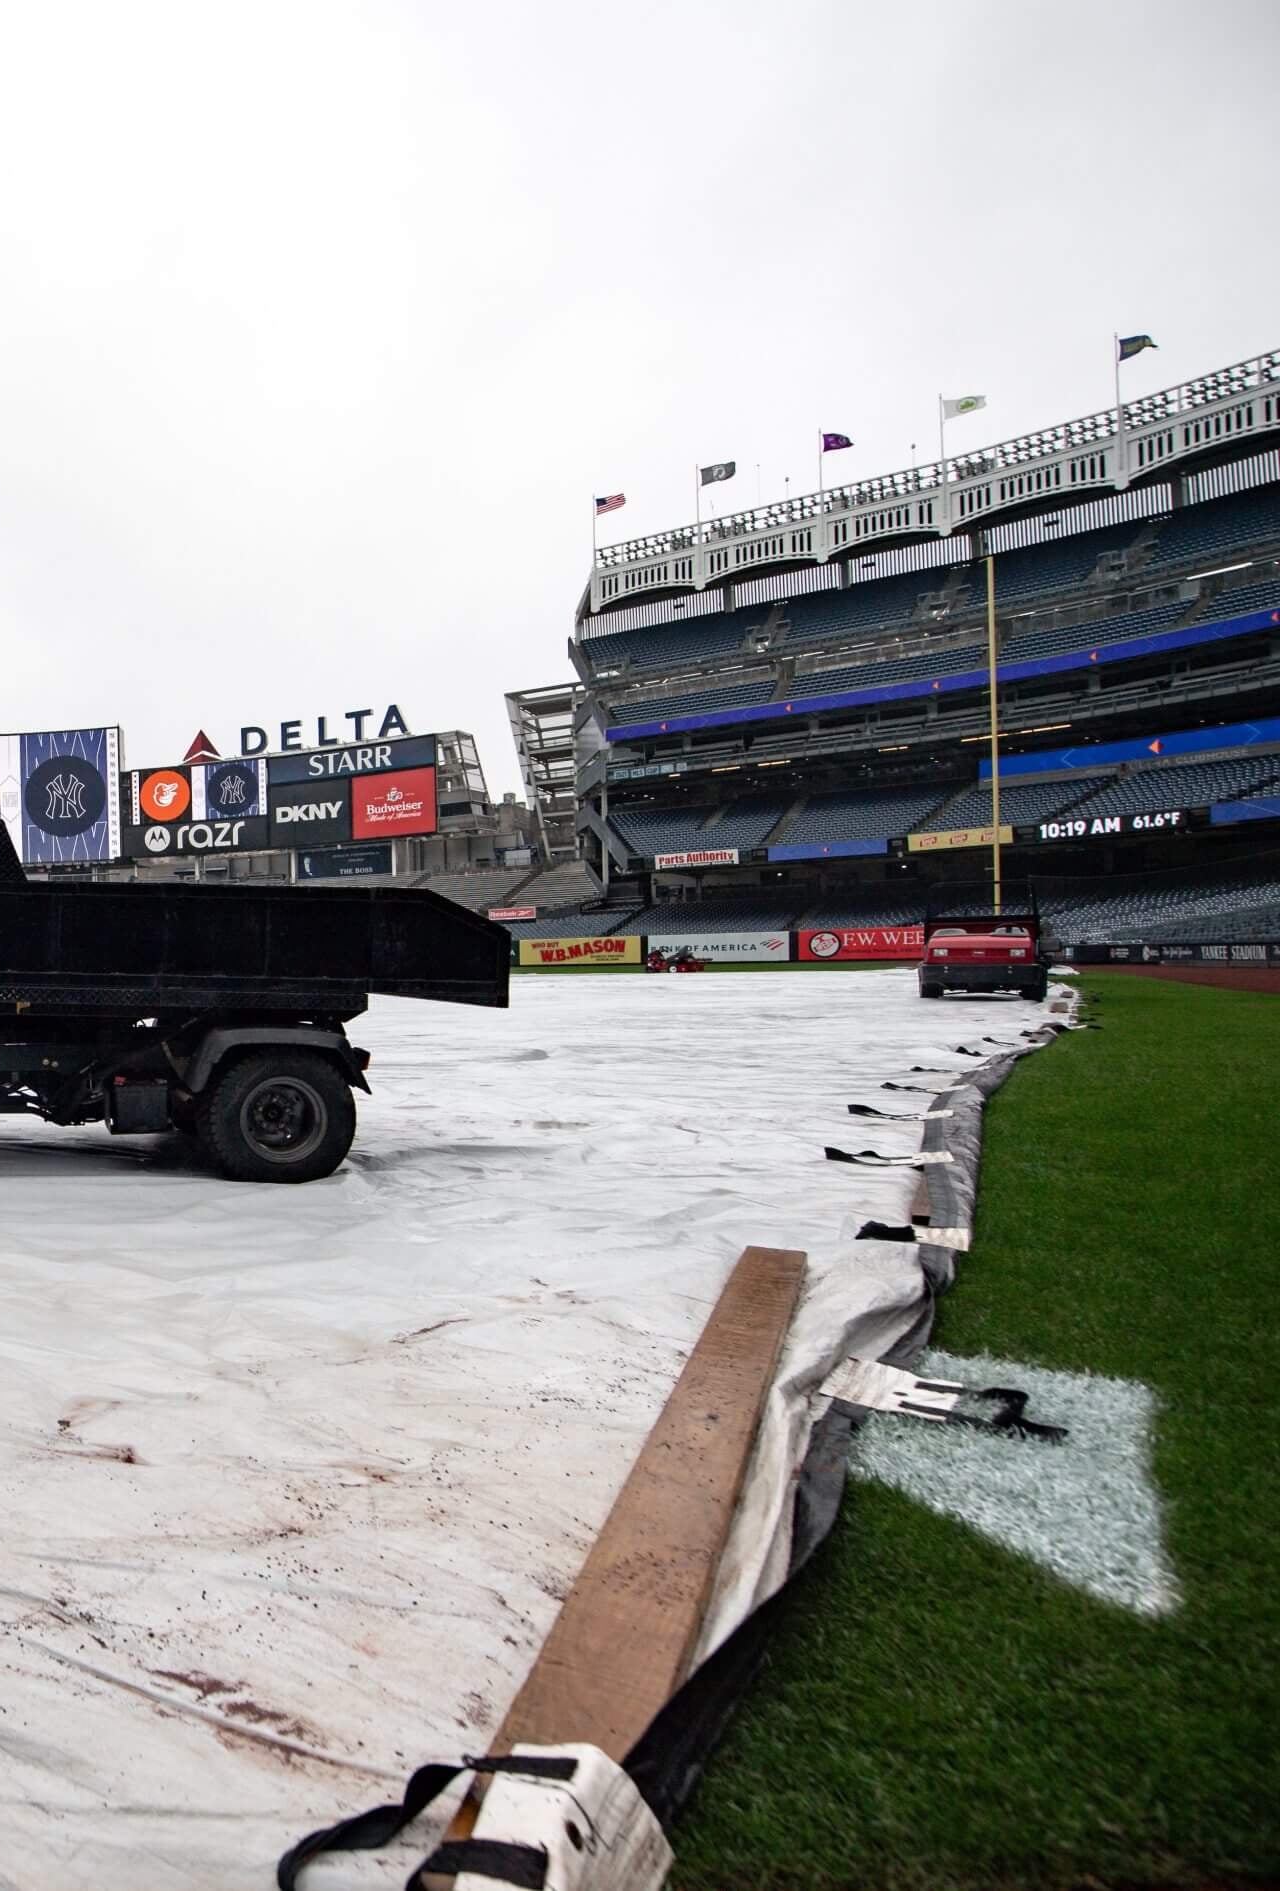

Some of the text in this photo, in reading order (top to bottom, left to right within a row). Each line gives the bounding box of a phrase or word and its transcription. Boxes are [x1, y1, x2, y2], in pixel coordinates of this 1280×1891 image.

[240, 704, 409, 756] DELTA
[308, 745, 393, 776] STARR
[275, 801, 343, 823] DKNY
[367, 801, 423, 815] Budweiser
[1040, 812, 1180, 839] 10:19 AM 61.6°F
[177, 821, 245, 849] razr
[658, 852, 733, 865] Parts Authority
[702, 943, 757, 952] AMERICA
[843, 932, 877, 946] F.W.
[1201, 945, 1228, 959] YANKEE
[1231, 945, 1266, 960] STADIUM
